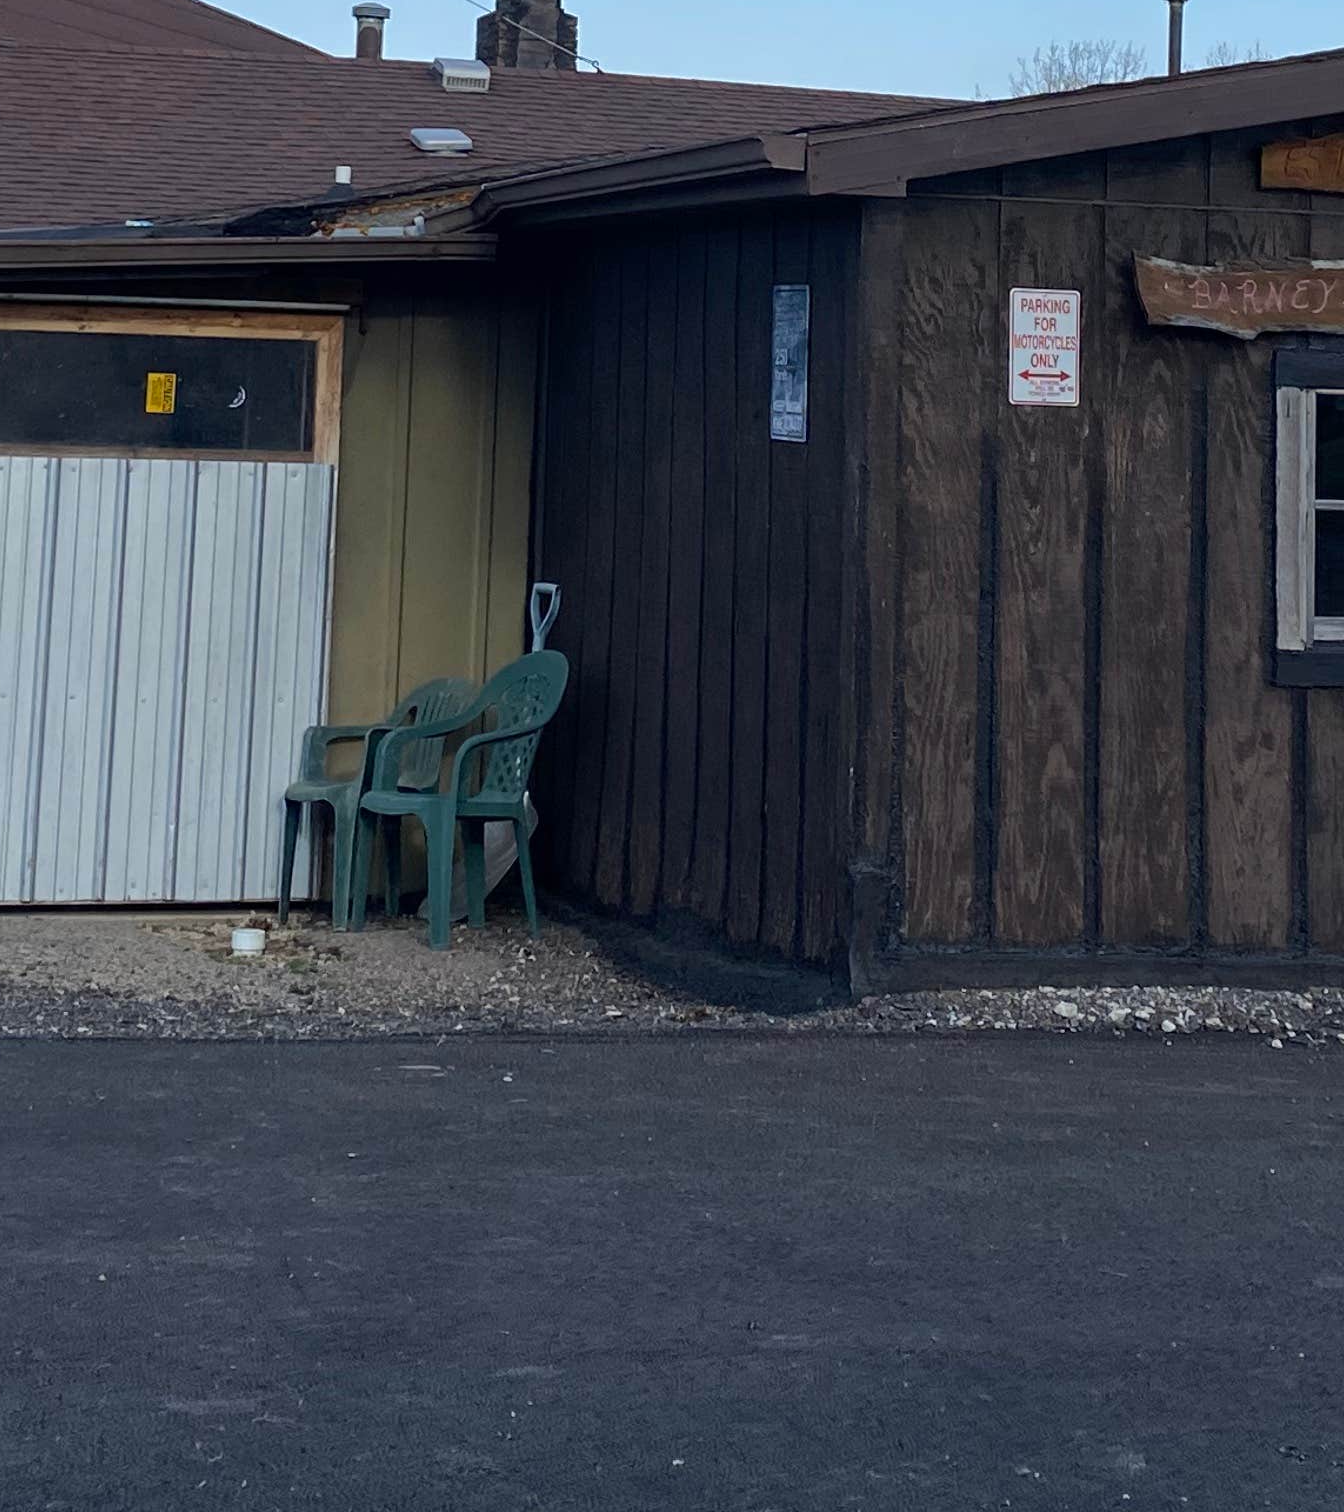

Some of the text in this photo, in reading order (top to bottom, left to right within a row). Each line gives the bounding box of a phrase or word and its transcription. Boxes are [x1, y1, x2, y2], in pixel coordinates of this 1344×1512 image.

[1020, 298, 1071, 314] PARKING
[1034, 317, 1057, 332] FOR
[1013, 333, 1077, 351] MOTORCYCLES
[1030, 353, 1060, 368] ONLY
